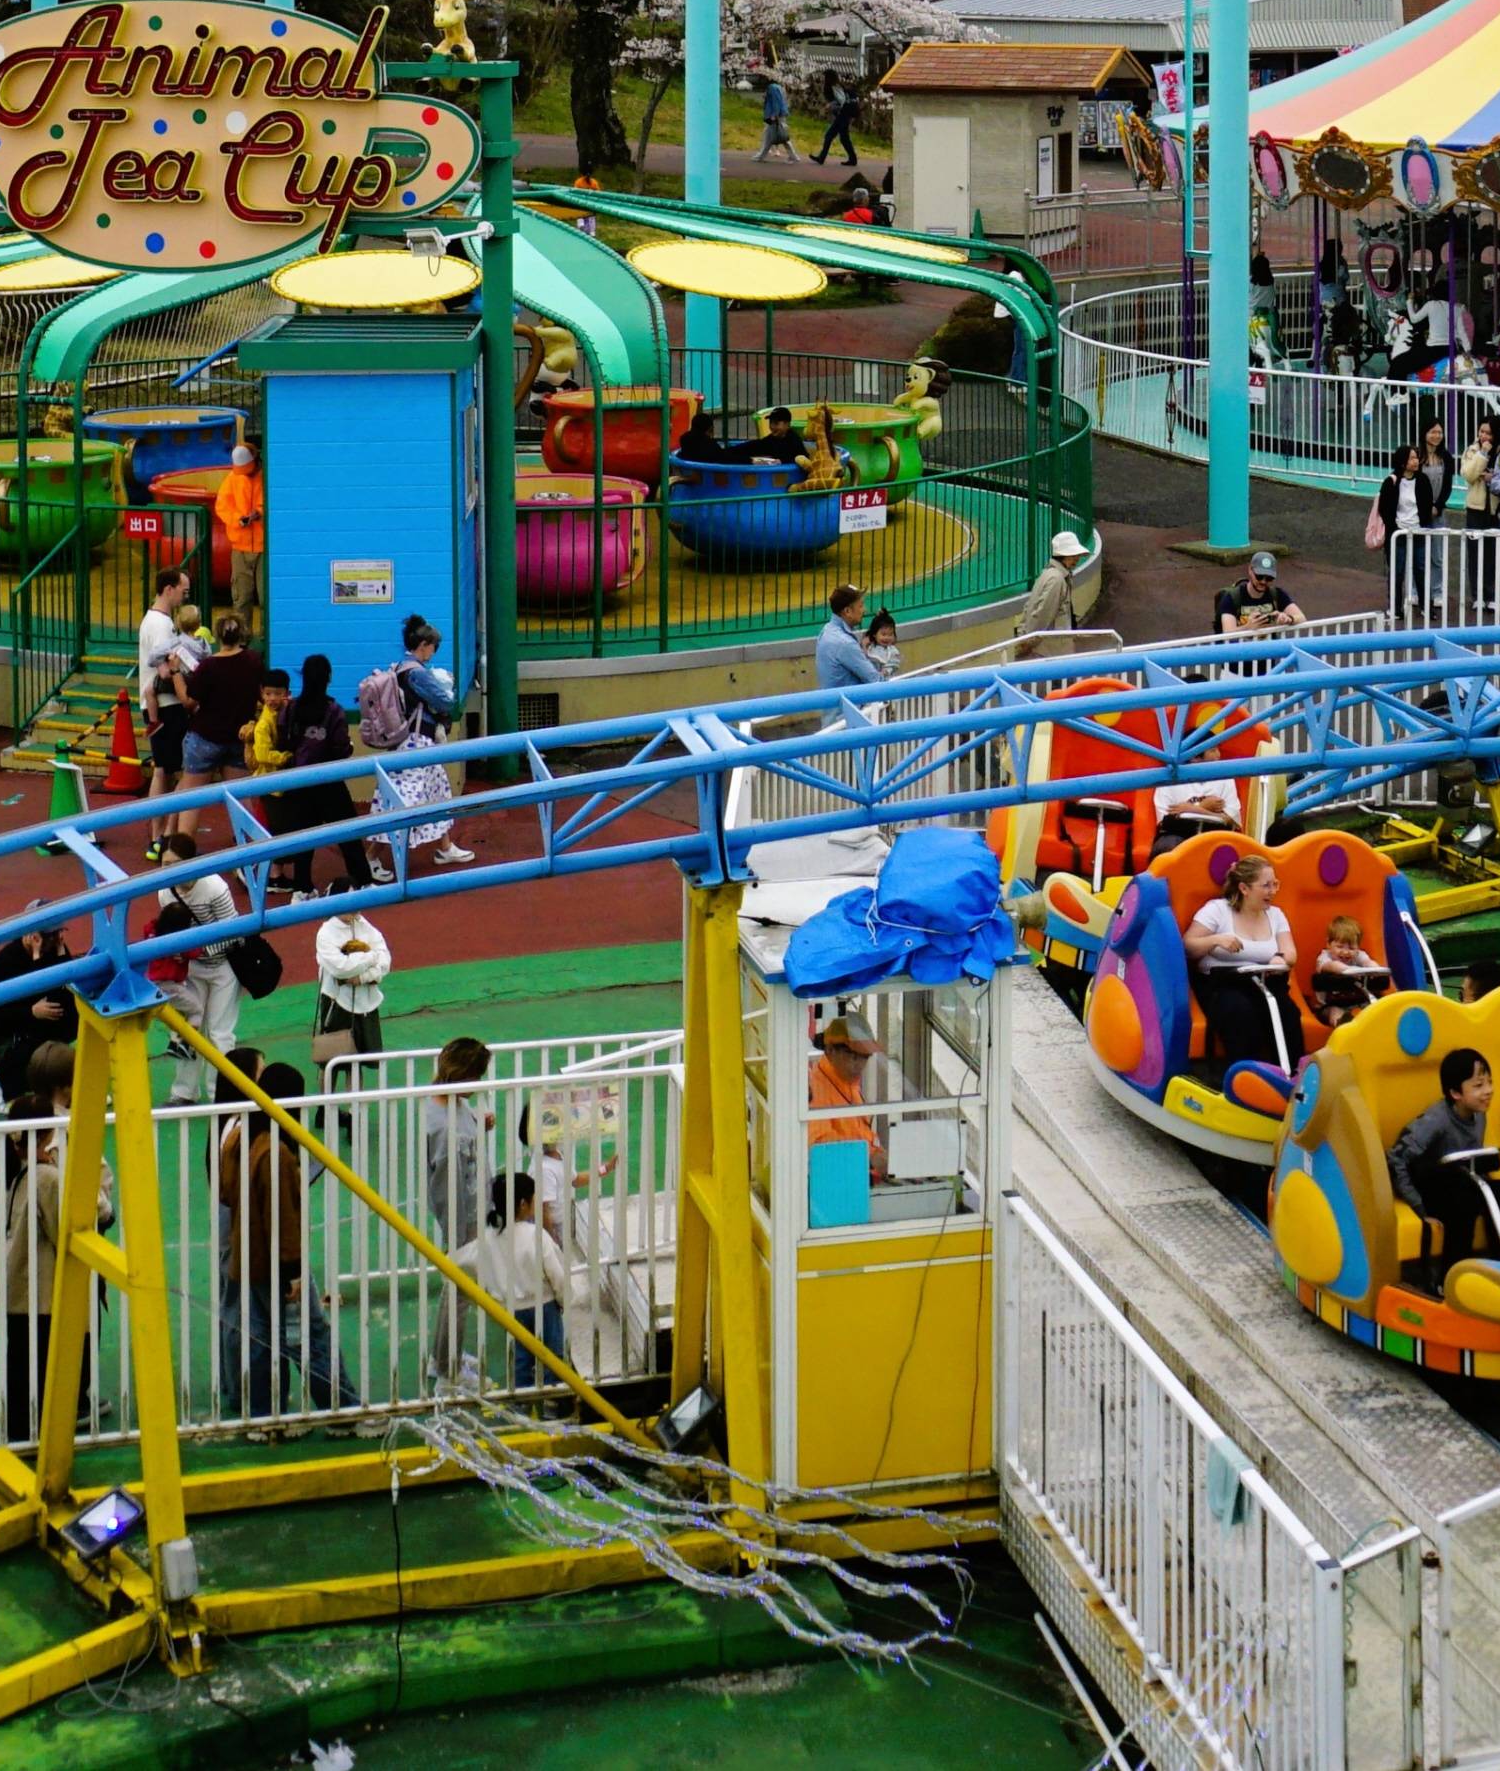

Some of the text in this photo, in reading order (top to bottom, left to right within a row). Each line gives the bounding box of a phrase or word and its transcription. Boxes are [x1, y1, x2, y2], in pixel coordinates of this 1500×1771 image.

[8, 107, 396, 254] Tea Cup
[845, 491, 882, 507] きけん
[130, 517, 157, 532] 出口
